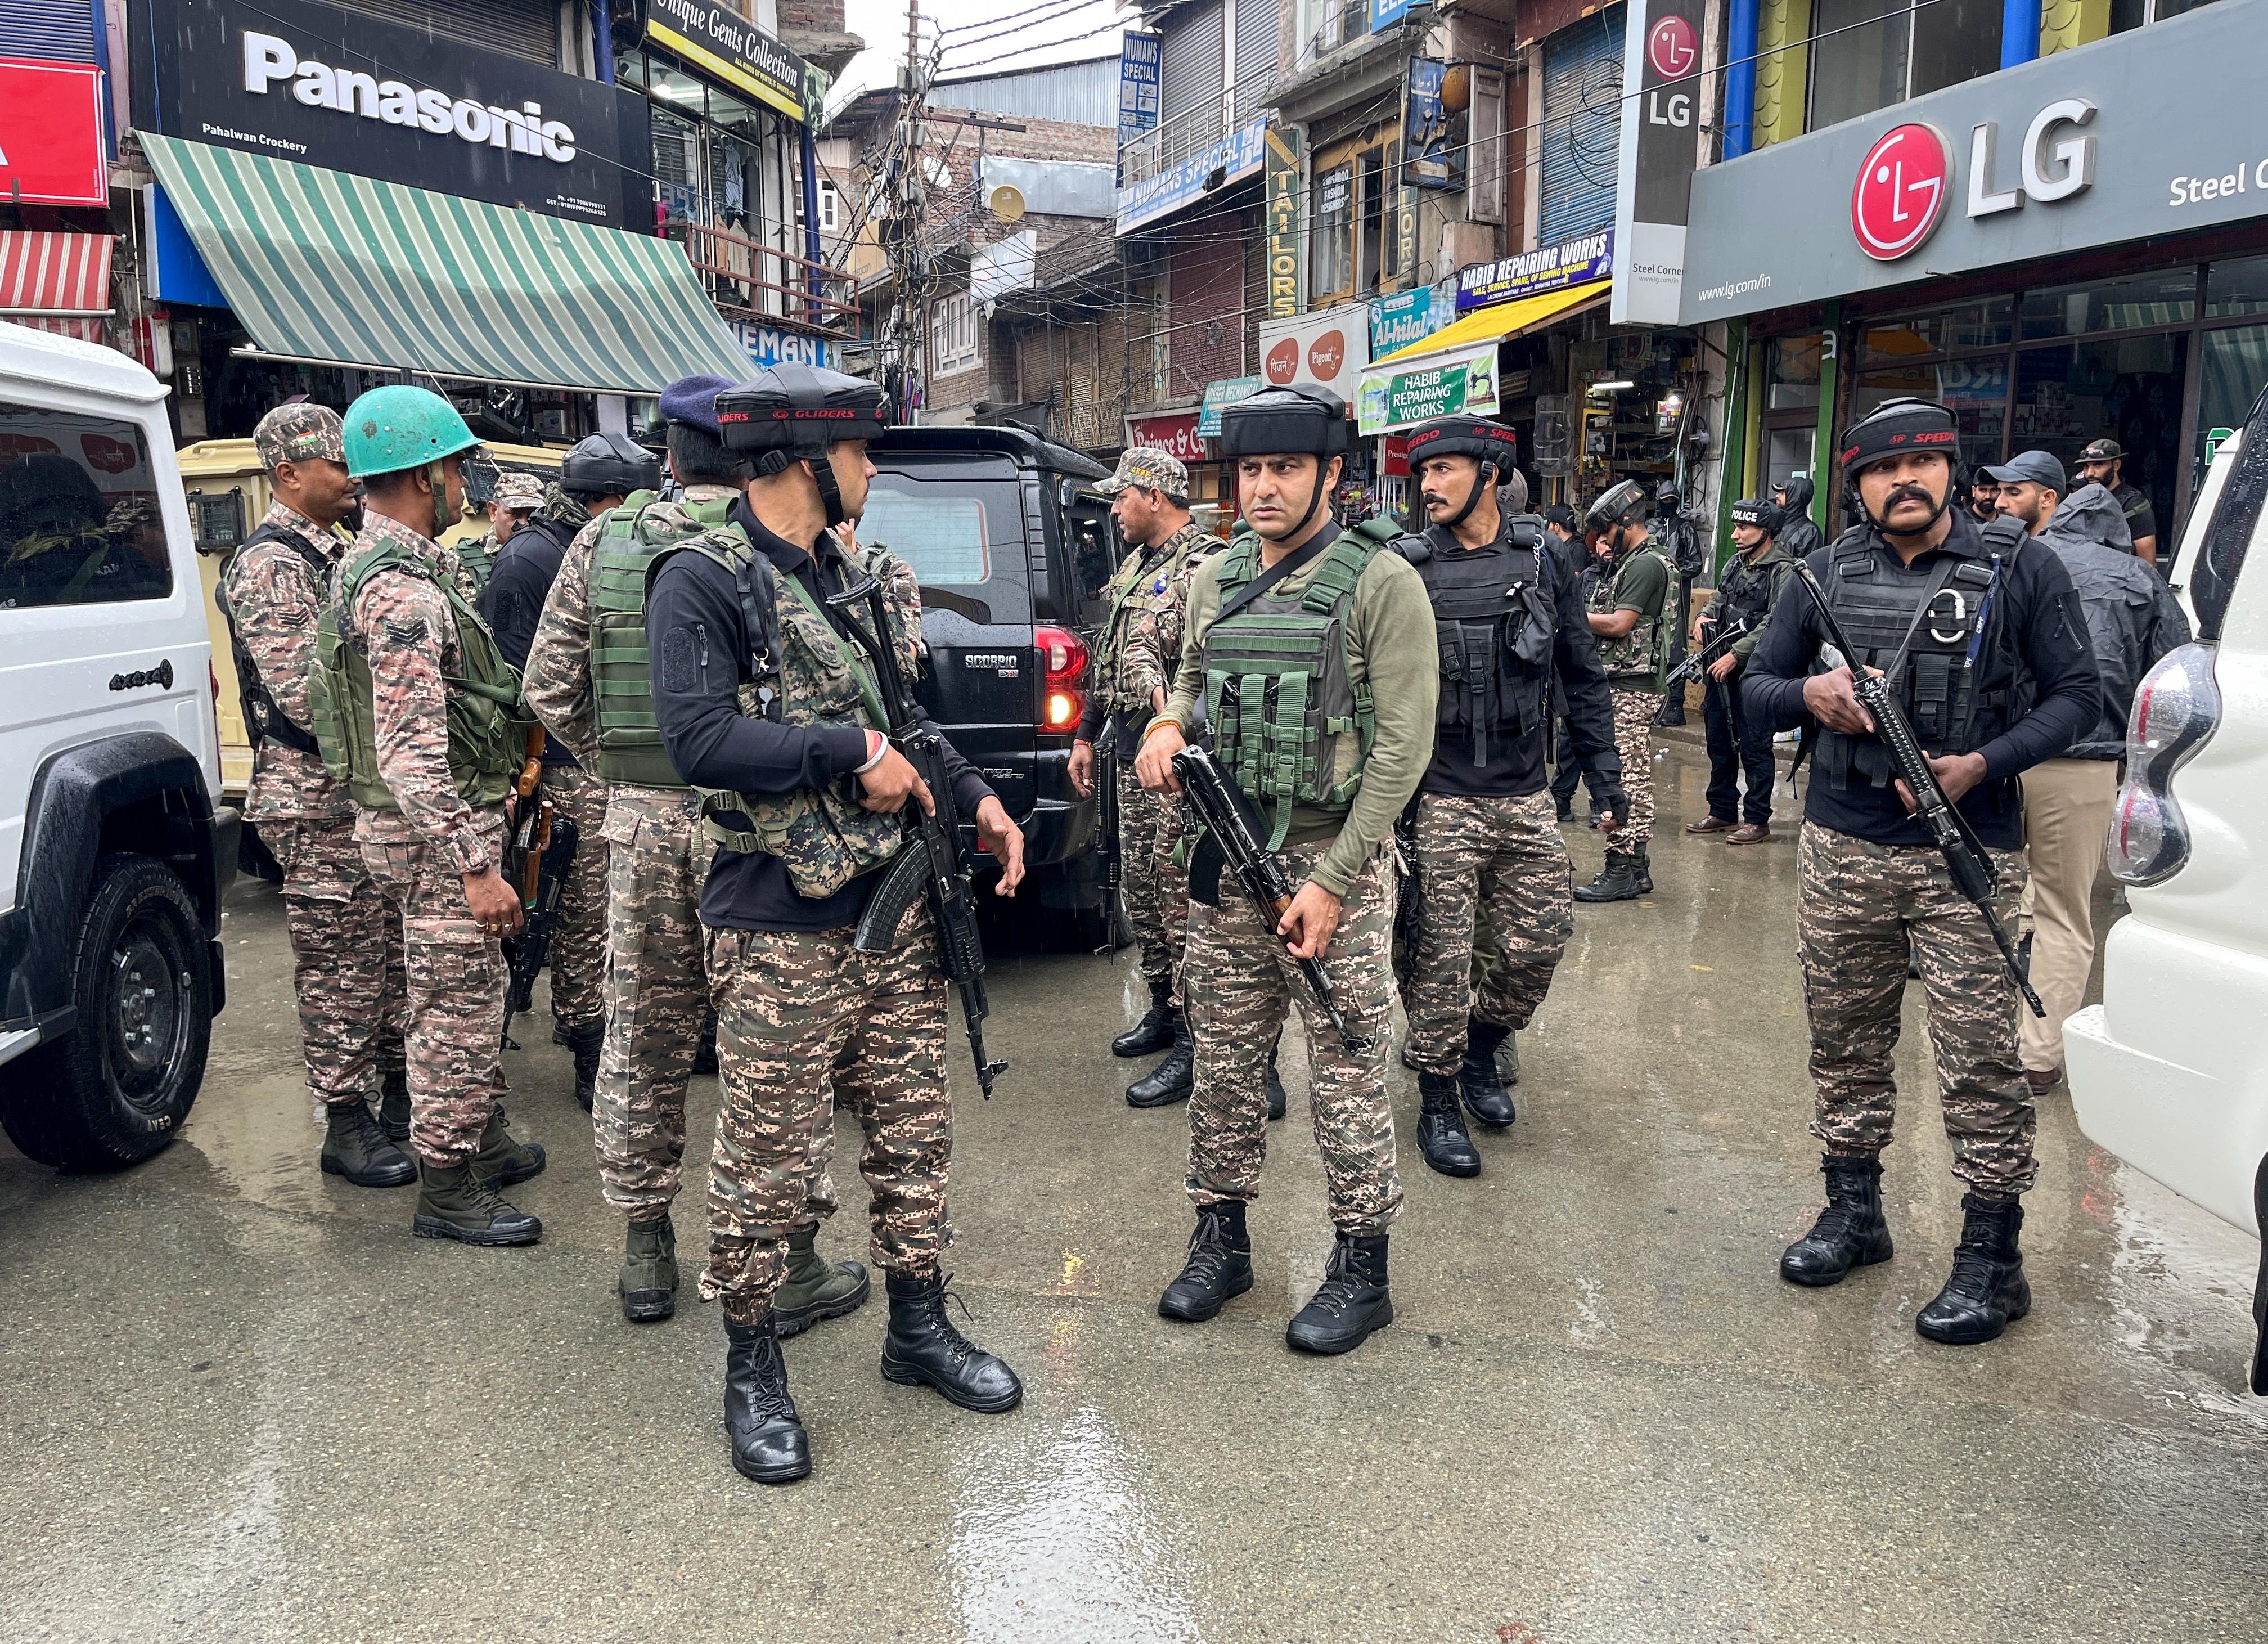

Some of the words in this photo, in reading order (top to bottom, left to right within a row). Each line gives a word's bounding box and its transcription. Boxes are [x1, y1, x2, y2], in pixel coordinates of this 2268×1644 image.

[709, 9, 743, 53] Gents
[745, 33, 798, 88] Collection
[1125, 38, 1158, 64] NUMANS
[1124, 62, 1155, 82] SPECIAL
[244, 30, 576, 163] Panasonic
[1649, 91, 1690, 127] LG
[202, 123, 257, 144] Pahalwan
[259, 133, 307, 155] Crockery
[1966, 97, 2098, 219] LG
[1135, 166, 1182, 208] NUMANS
[1185, 137, 1239, 183] SPECIAL
[2168, 161, 2246, 207] Steel
[1271, 170, 1296, 317] TAILORS
[1461, 263, 1496, 291] HABIB
[1497, 246, 1558, 282] REPAIRING
[1560, 233, 1608, 266] WORKS
[1632, 263, 1655, 275] Steel
[1472, 286, 1487, 297] SALE,
[1487, 280, 1510, 293] SERVICE,
[1511, 275, 1530, 289] SPARE,
[1531, 273, 1539, 281] OF
[1539, 267, 1562, 281] SEWING
[1562, 260, 1589, 276] MACHINE
[1639, 275, 1679, 284] www.lg.com/in
[1698, 273, 1771, 302] www.lg.com/in
[1270, 358, 1288, 374] पिजन
[1311, 352, 1333, 366] Pigeon
[1405, 371, 1441, 390] HABIB
[1393, 383, 1452, 407] REPAIRING
[795, 410, 856, 418] GLIDERS
[1399, 401, 1445, 421] WORKS
[1135, 430, 1175, 455] Prince
[1176, 428, 1189, 455] &
[1387, 450, 1408, 460] Prestige
[1731, 509, 1758, 522] POLICE
[1976, 615, 1984, 634] CRPF
[965, 654, 1018, 669] SCORPIO
